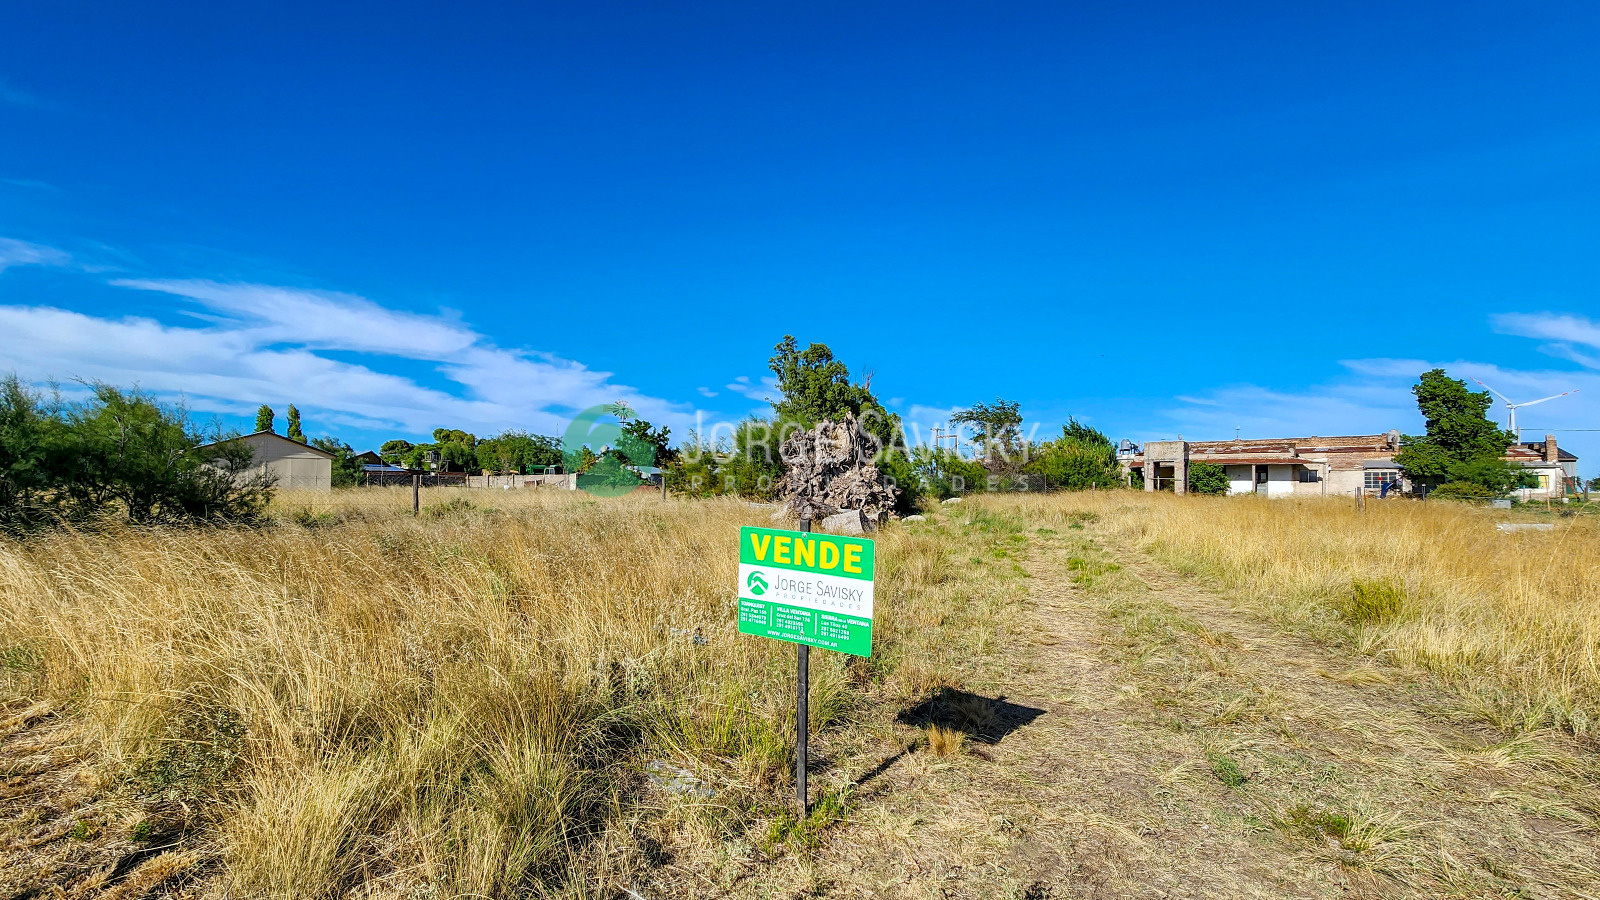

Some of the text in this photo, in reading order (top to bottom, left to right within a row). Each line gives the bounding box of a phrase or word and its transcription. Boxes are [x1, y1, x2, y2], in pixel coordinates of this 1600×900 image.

[750, 533, 863, 574] VENDE
[775, 574, 864, 602] JORGE SAVISKY
[775, 592, 861, 611] PROPIEDADES
[776, 607, 789, 615] VILLA
